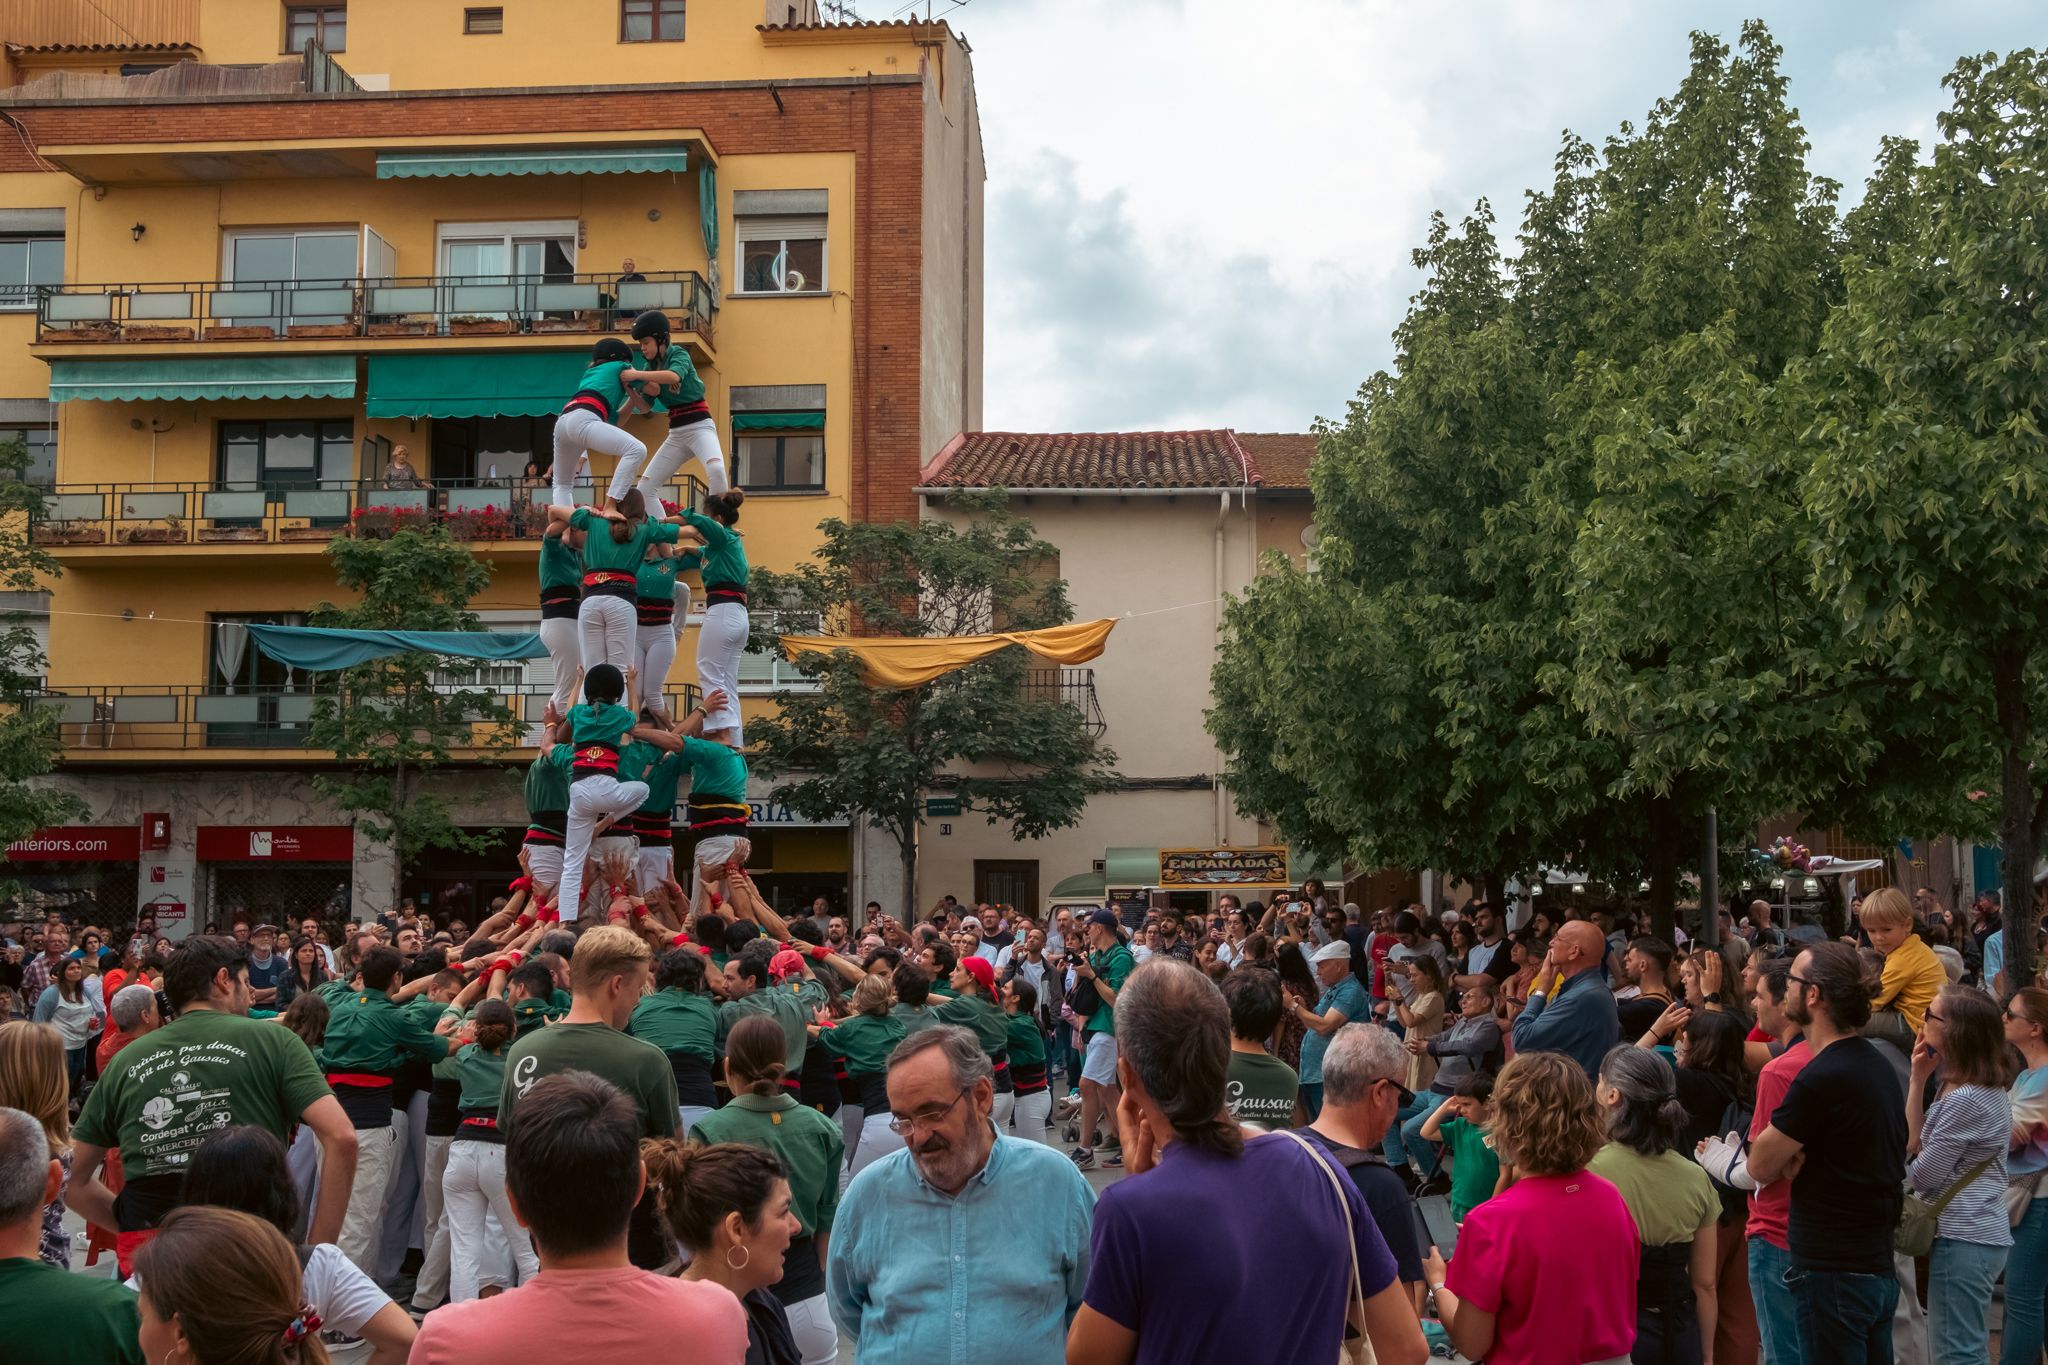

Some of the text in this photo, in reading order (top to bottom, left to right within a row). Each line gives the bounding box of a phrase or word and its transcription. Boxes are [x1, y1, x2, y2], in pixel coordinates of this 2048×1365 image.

[1169, 857, 1280, 869] EMPANADAS
[179, 1043, 202, 1056] per
[206, 1040, 248, 1058] donar
[139, 1054, 230, 1084] pit als Gausacs
